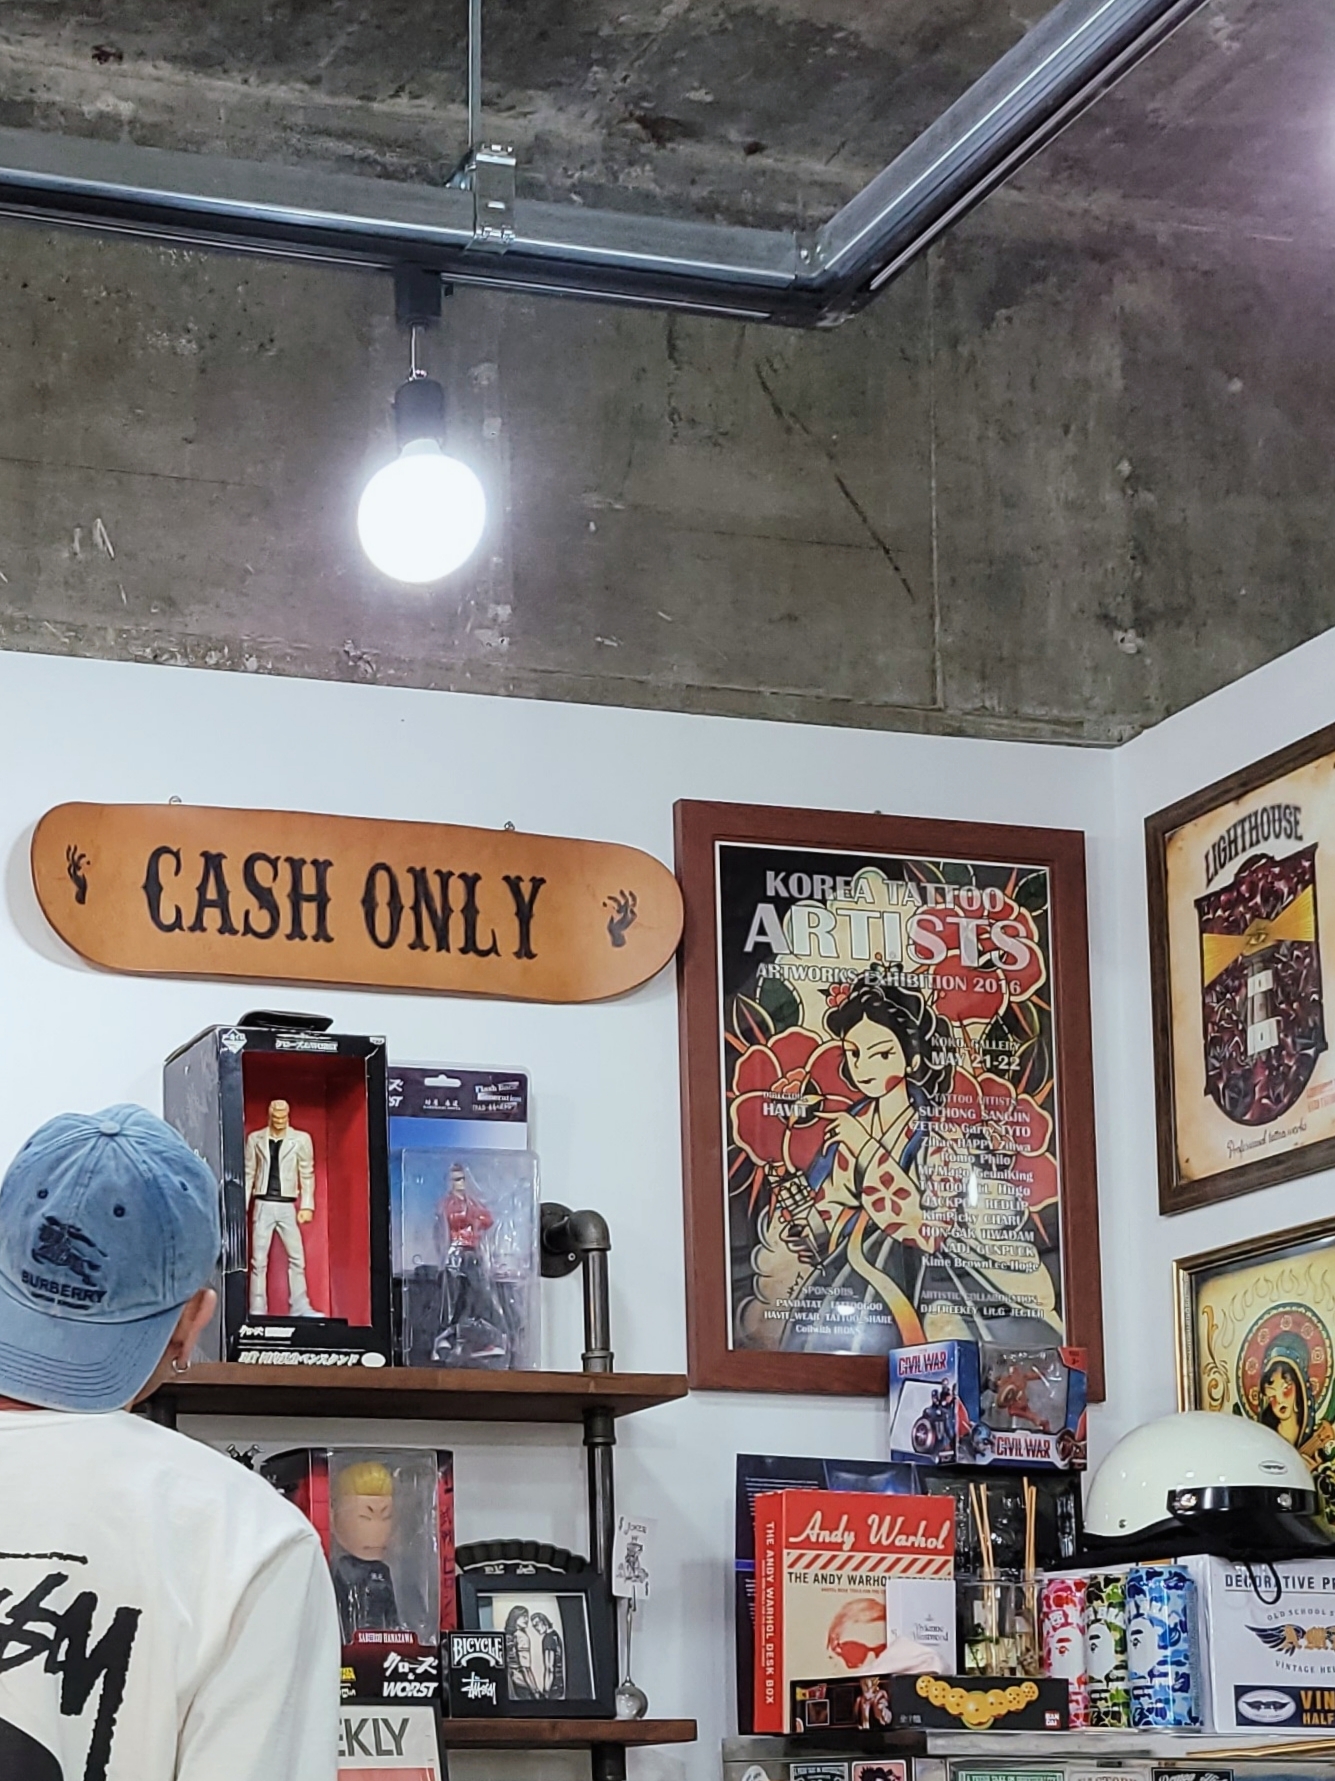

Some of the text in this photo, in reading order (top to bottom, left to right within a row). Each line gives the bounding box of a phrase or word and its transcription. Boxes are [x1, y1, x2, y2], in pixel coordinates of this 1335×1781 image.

[1204, 802, 1304, 888] LIGHTHOUSE
[141, 845, 546, 960] CASH ONLY
[766, 870, 1004, 912] KOREA TATTOO
[744, 902, 1032, 970] ARTISTS
[756, 963, 1021, 995] ARTWORKS EXHIBITION 2016
[971, 1055, 1021, 1070] 21-22
[763, 1102, 808, 1117] HAVIT
[21, 1270, 107, 1303] BURBERRY
[899, 1351, 948, 1376] CIVIL WAR
[996, 1436, 1051, 1459] CIVIL WAR
[789, 1511, 950, 1551] Andy Warhol
[788, 1572, 809, 1583] THE
[813, 1573, 843, 1585] ANDY
[765, 1521, 775, 1704] THE ANDY WARHOL DESK BOX
[1268, 1608, 1326, 1621] OLD SCHOOL
[452, 1635, 503, 1667] BICYCLE
[1276, 1660, 1315, 1674] VINTAGE
[382, 1681, 438, 1697] WORST
